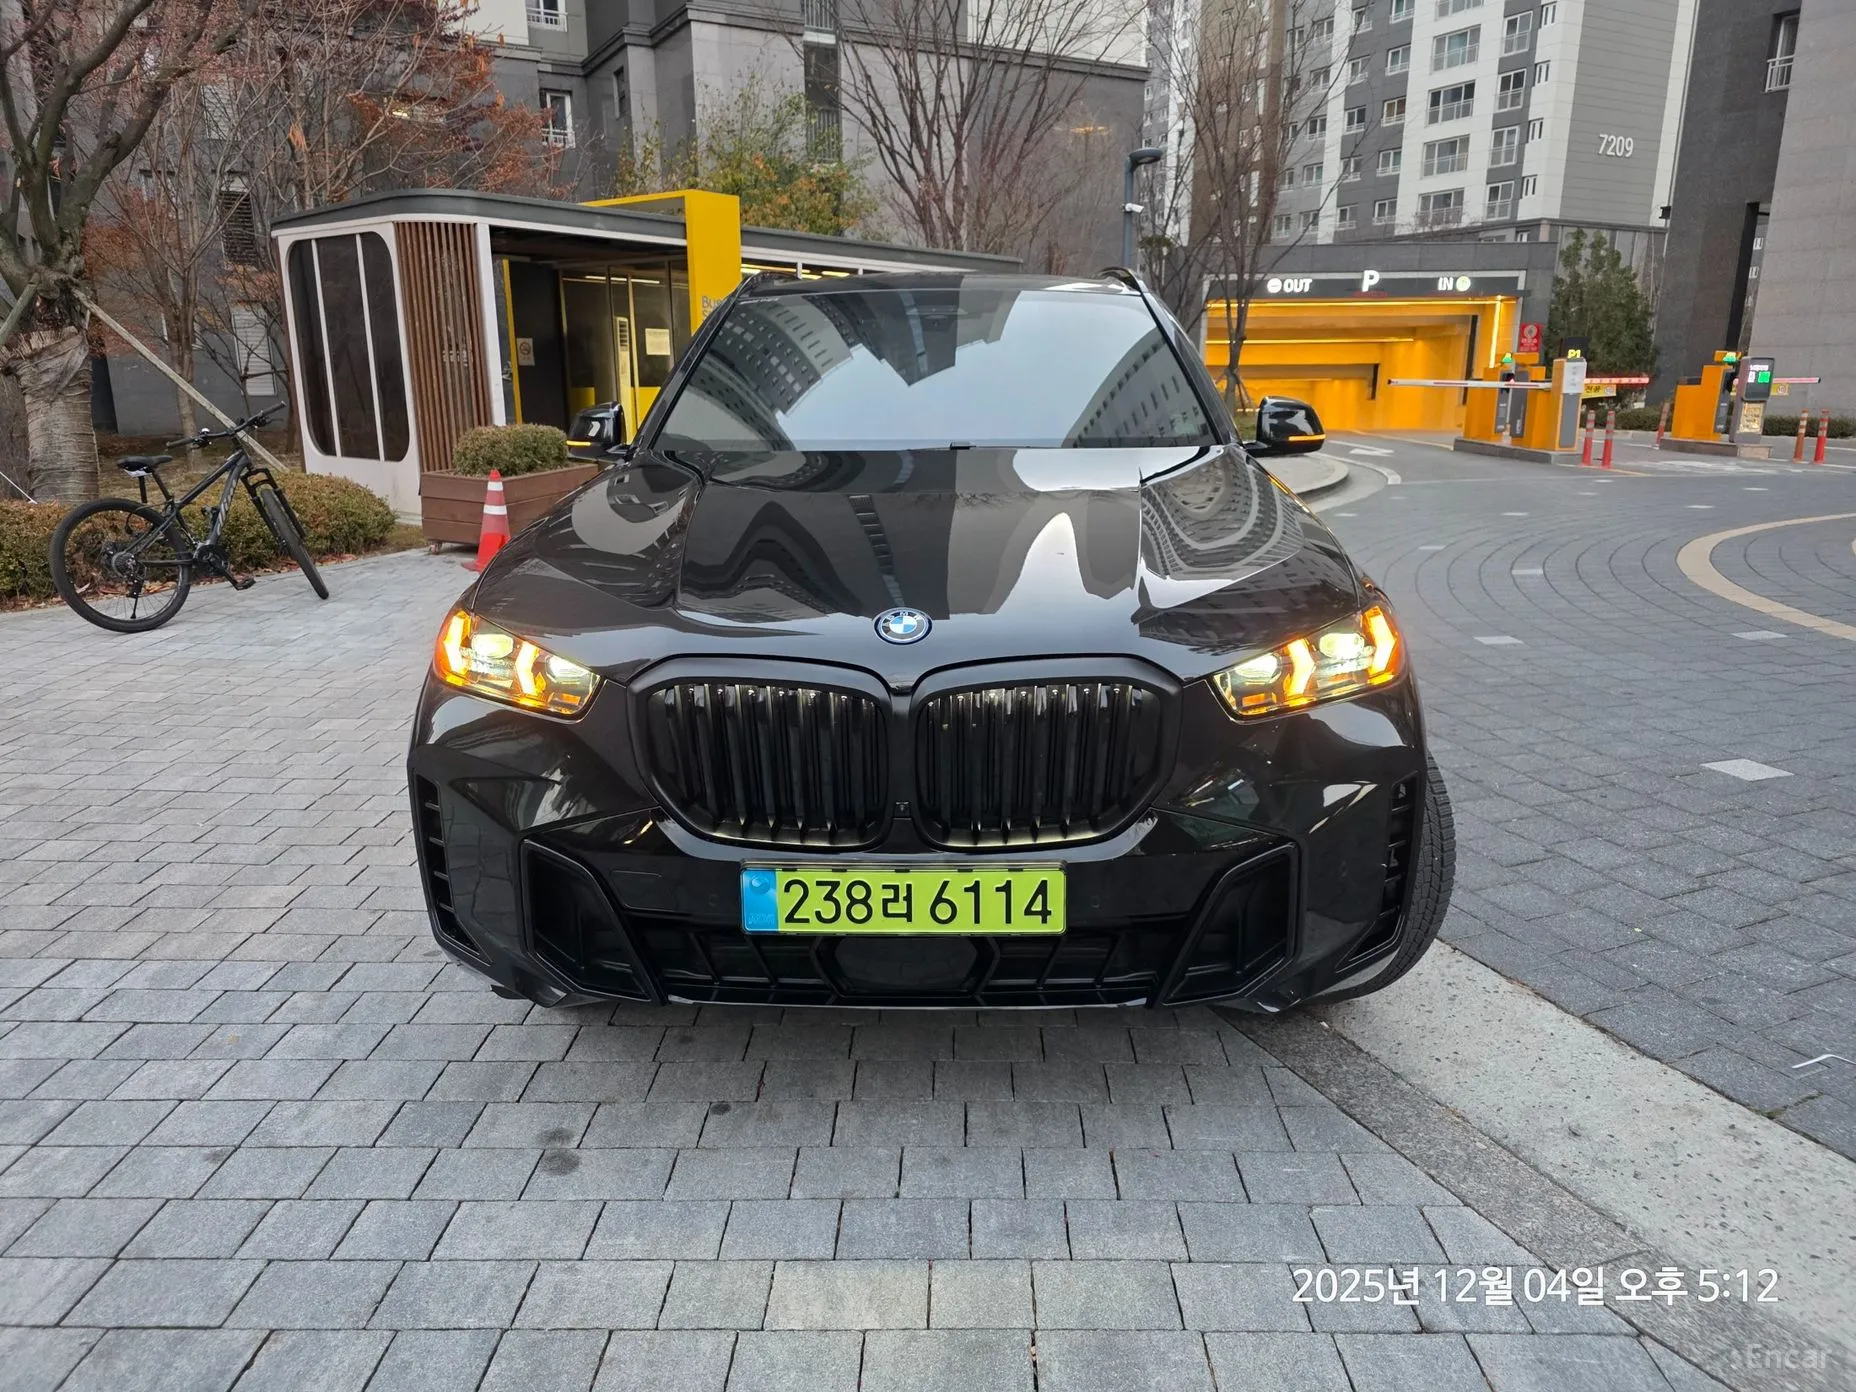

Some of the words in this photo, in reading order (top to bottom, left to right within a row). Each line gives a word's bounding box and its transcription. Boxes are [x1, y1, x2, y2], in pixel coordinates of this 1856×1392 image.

[1599, 134, 1633, 157] 7209
[1284, 279, 1312, 292] OUT
[1362, 270, 1380, 292] P
[1438, 277, 1453, 290] IN
[1567, 349, 1581, 358] P1
[783, 879, 913, 924] 238러
[929, 880, 1052, 924] 6114
